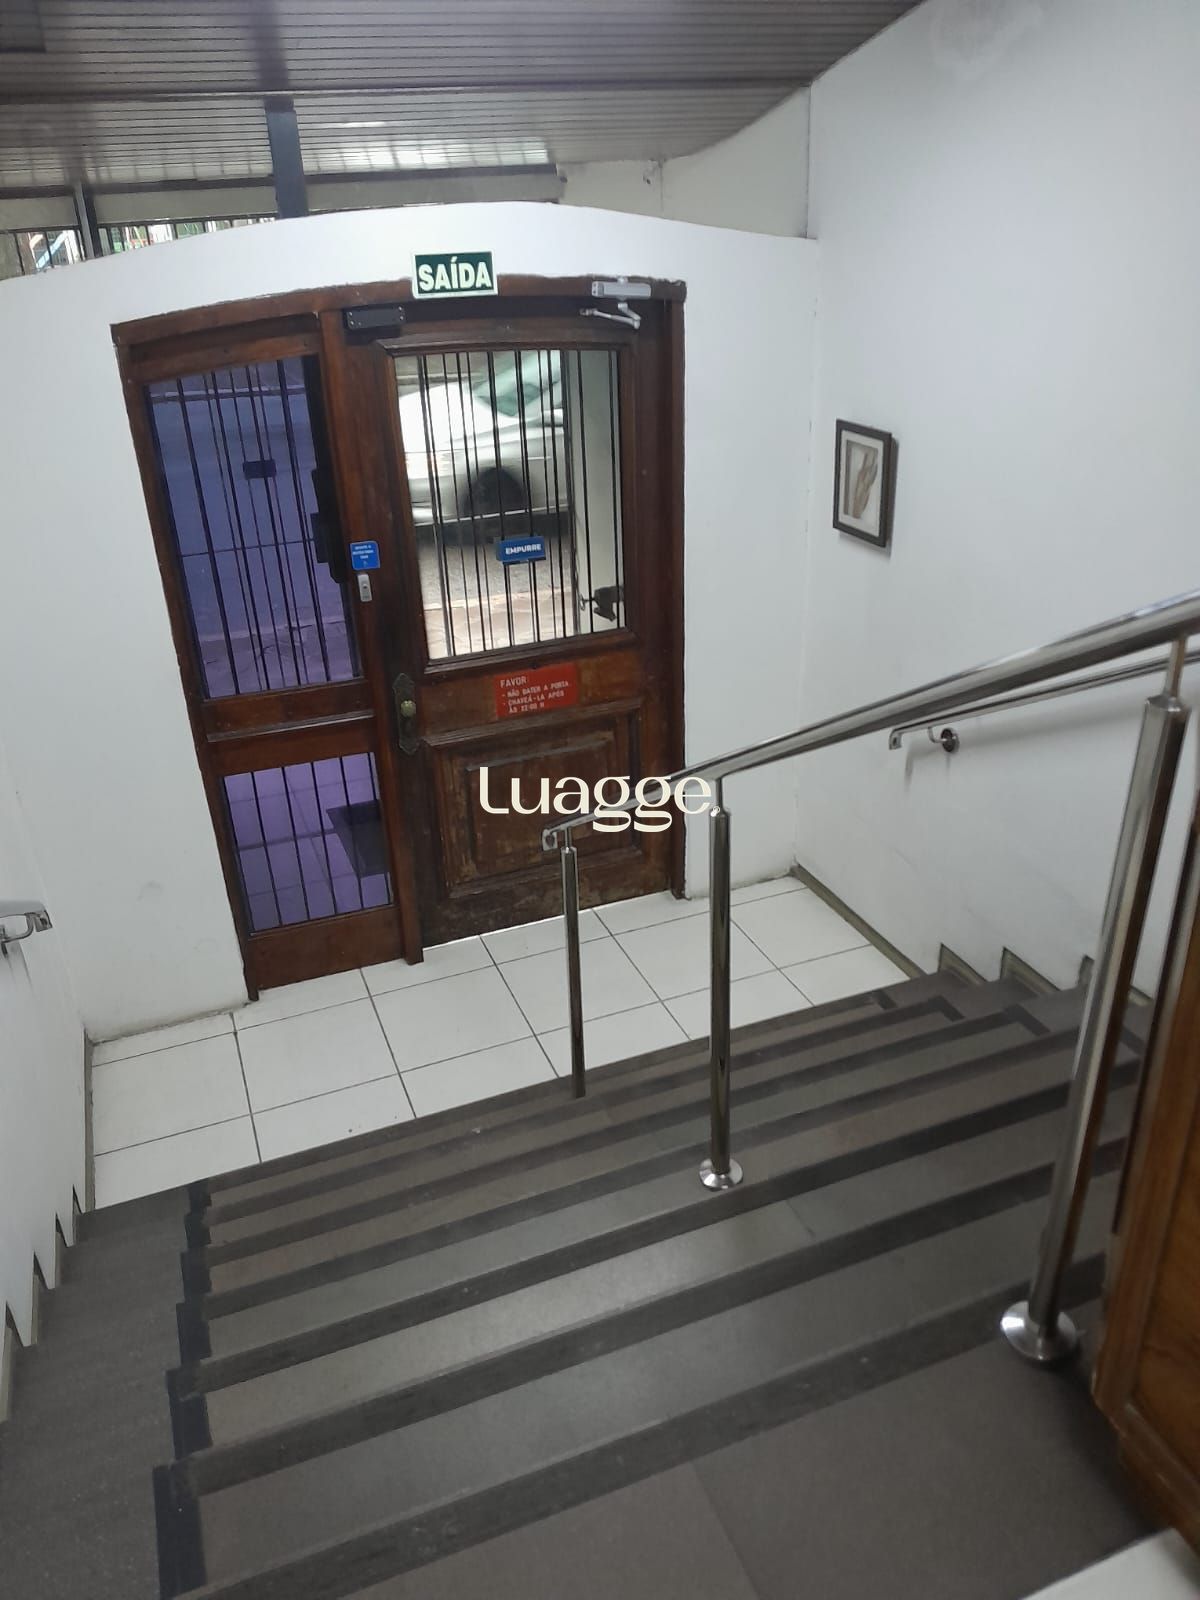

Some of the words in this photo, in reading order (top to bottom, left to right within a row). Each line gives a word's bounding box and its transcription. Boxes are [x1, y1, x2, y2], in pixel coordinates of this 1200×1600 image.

[418, 256, 492, 291] SAÍDA
[505, 543, 542, 555] EMPURRE
[507, 688, 520, 698] NÃO
